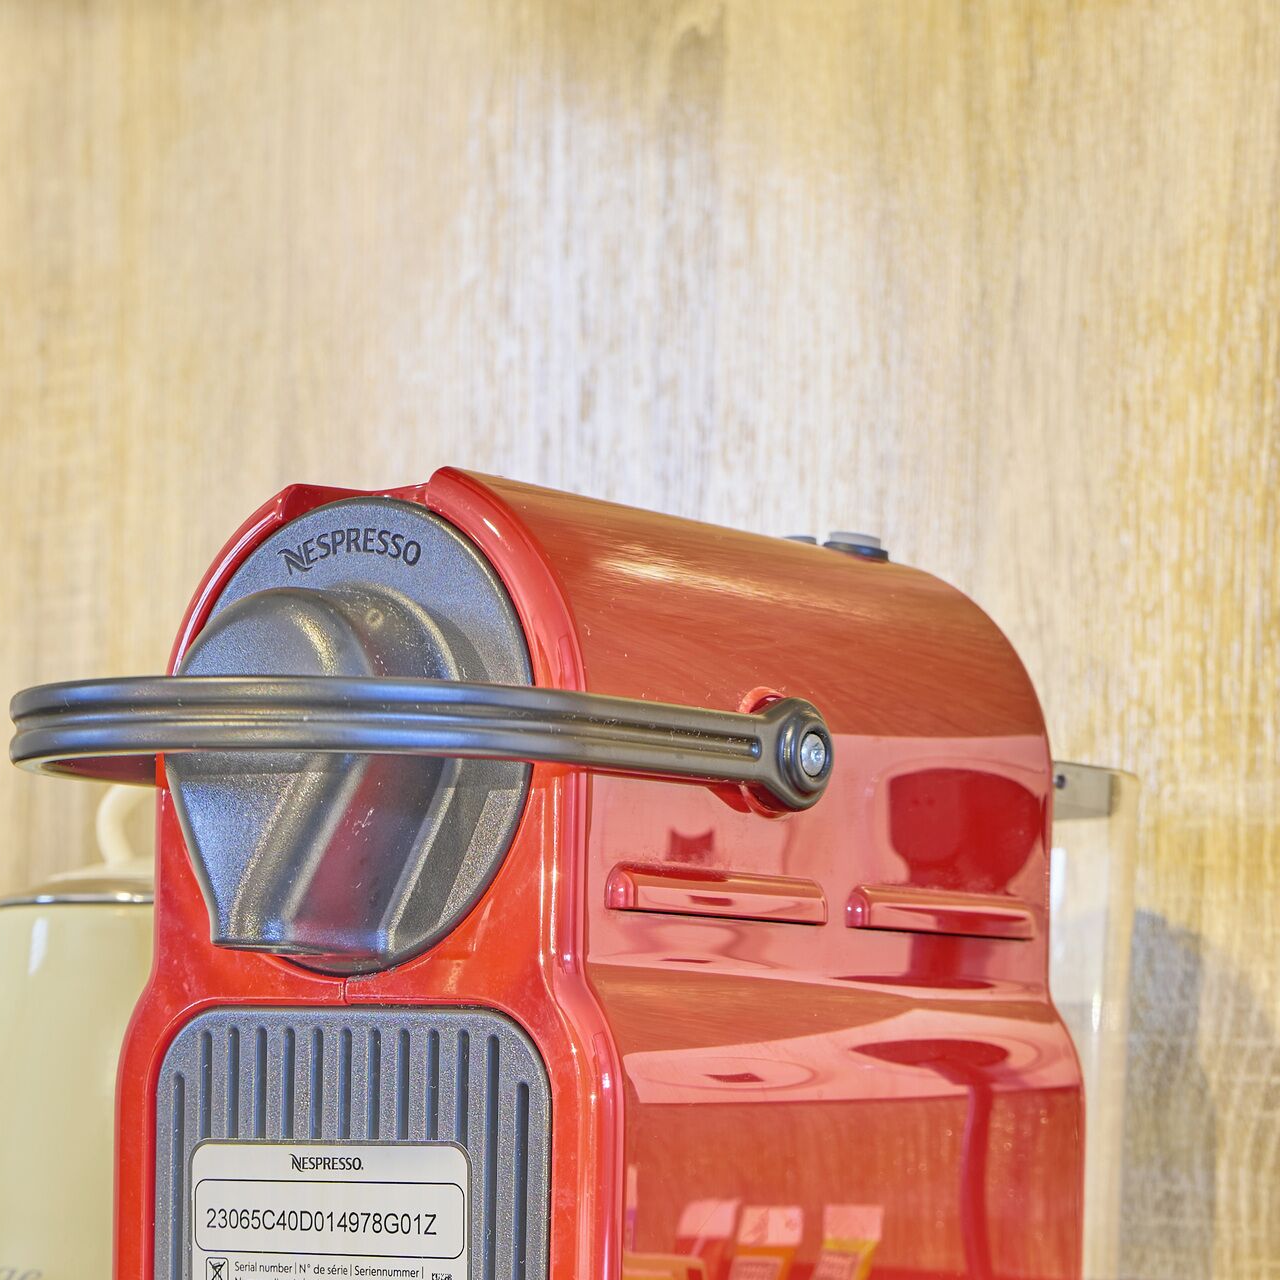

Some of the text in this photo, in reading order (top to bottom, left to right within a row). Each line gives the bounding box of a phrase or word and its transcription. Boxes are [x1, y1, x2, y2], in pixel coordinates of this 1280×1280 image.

[277, 527, 422, 576] NESPRESSO
[206, 1208, 437, 1236] 23065C40D014978G01Z
[234, 1261, 258, 1273] Serial
[259, 1263, 293, 1274] number
[313, 1264, 325, 1275] de
[327, 1264, 348, 1276] série
[354, 1265, 420, 1278] Seriennummer
